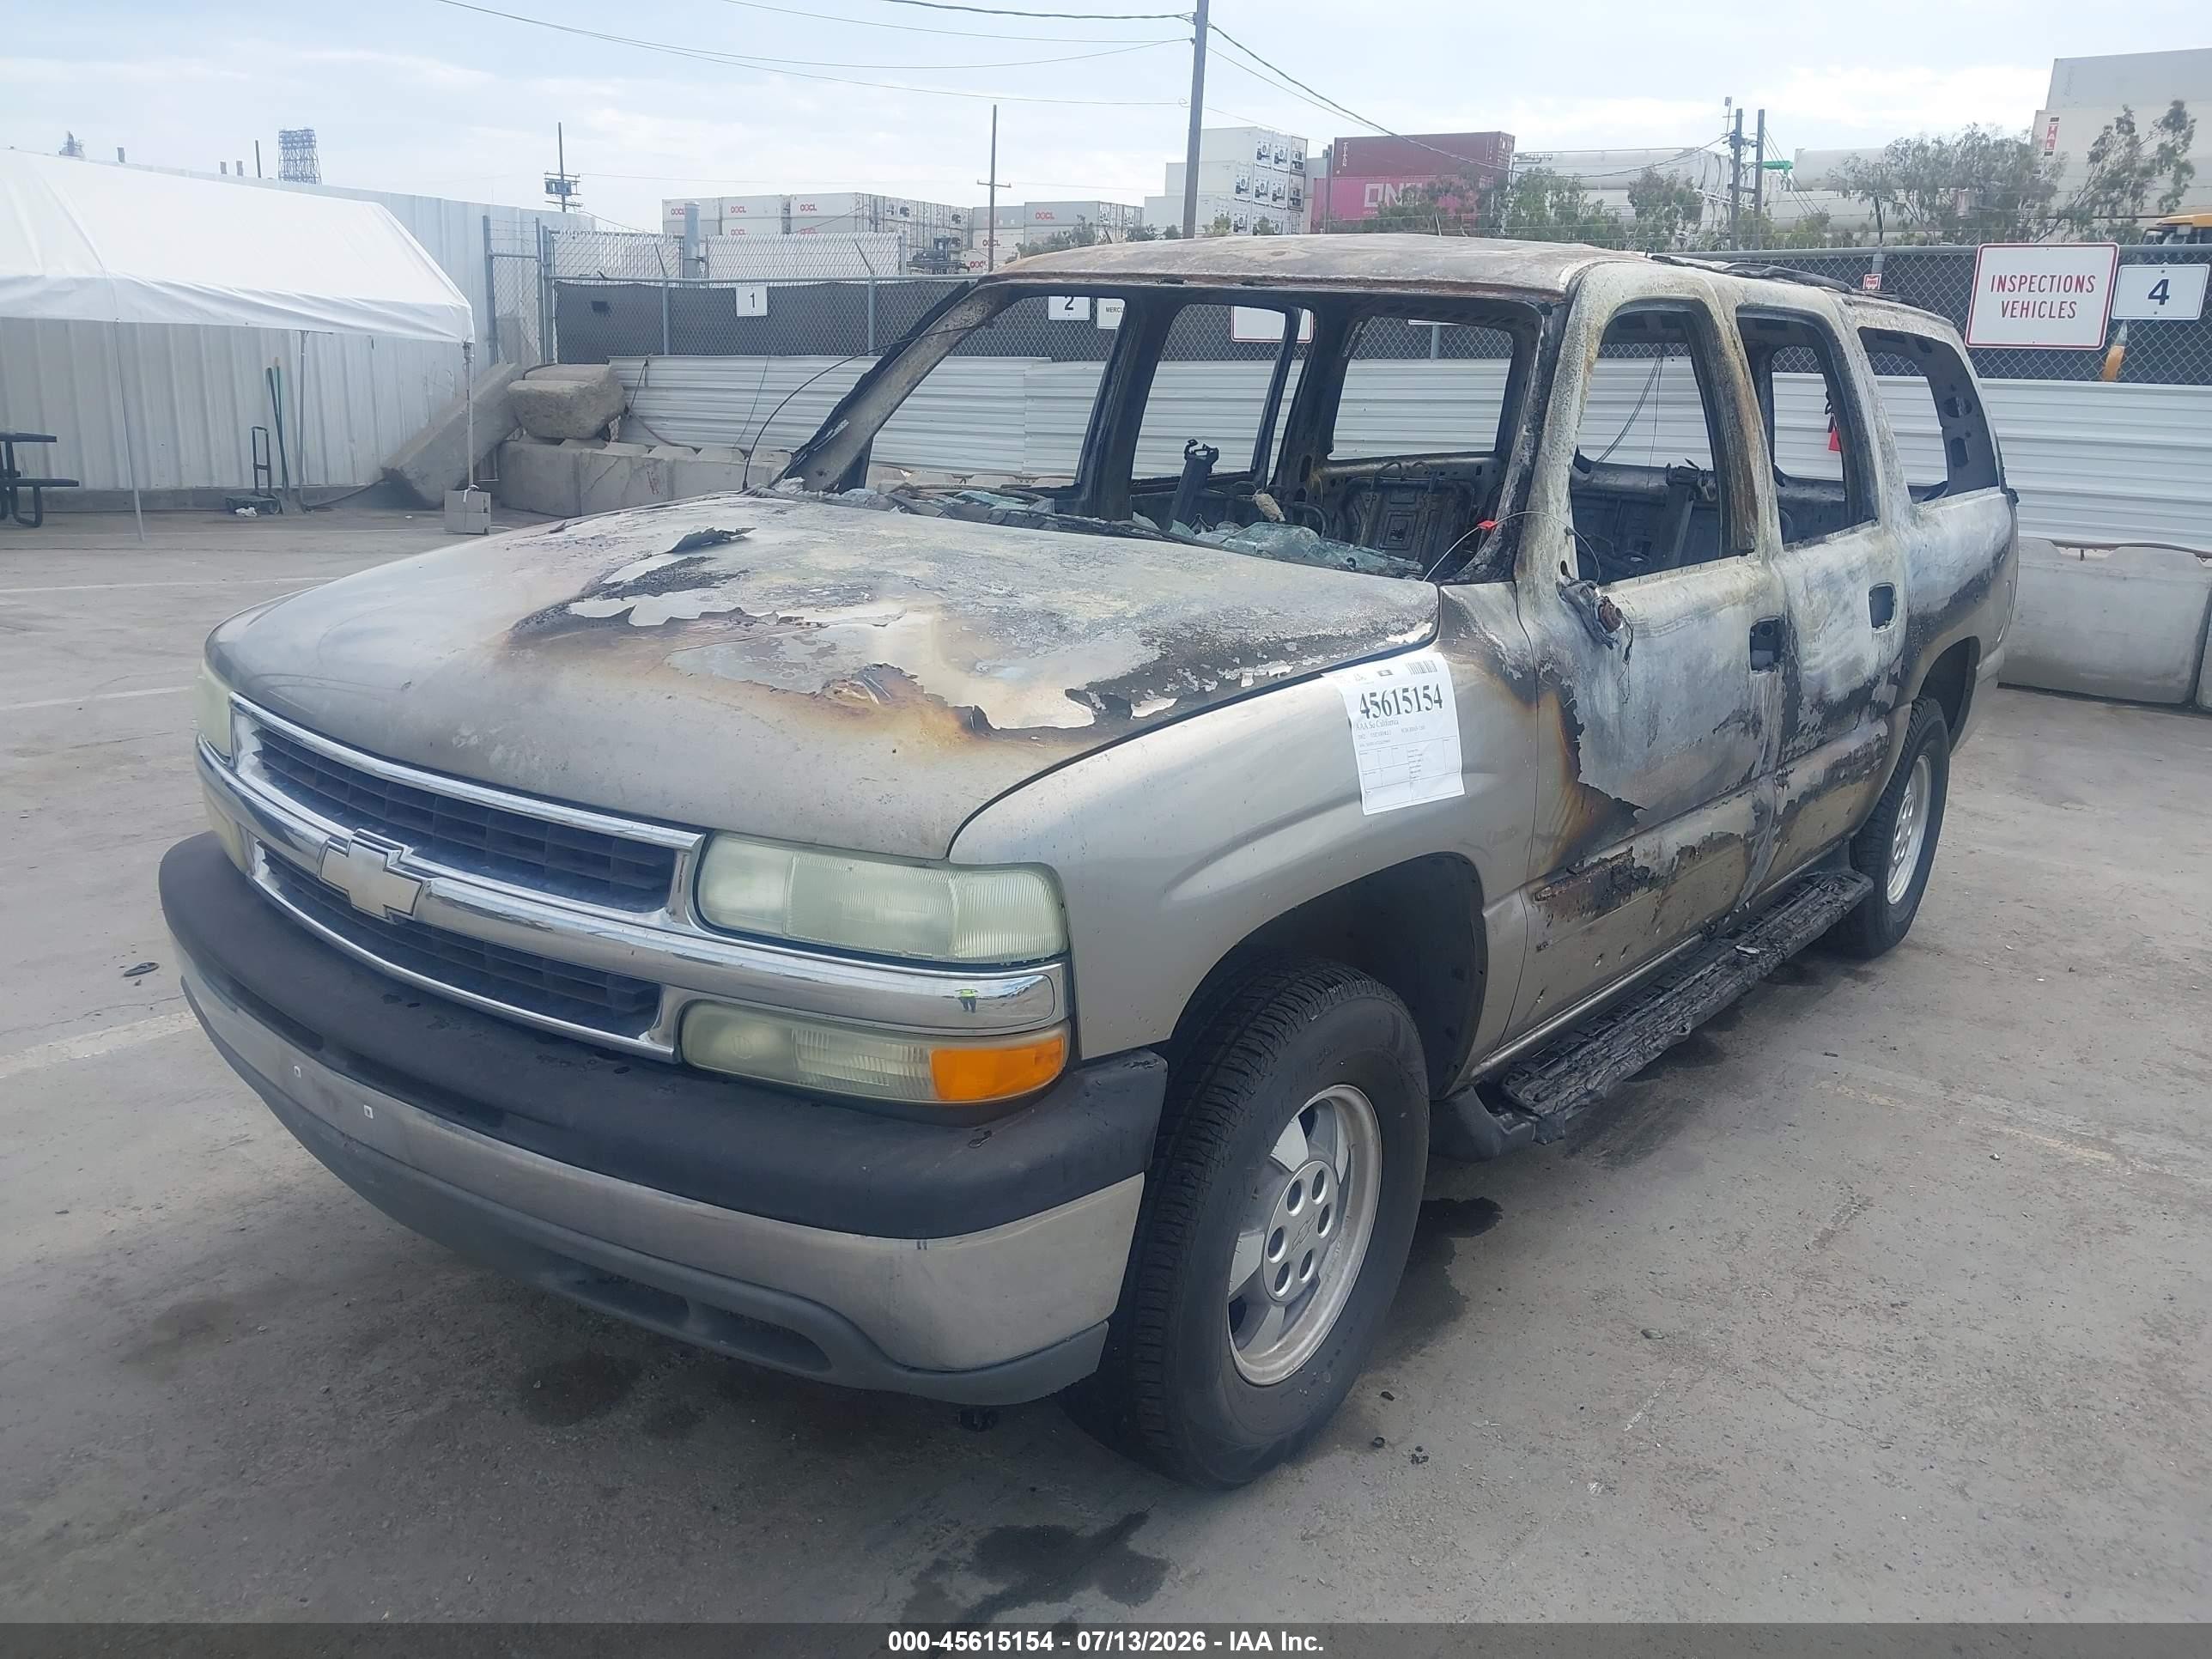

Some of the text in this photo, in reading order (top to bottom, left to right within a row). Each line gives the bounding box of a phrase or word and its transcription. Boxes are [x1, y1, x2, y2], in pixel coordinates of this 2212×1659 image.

[1364, 182, 1423, 208] ON
[730, 205, 747, 214] OOCL
[799, 204, 817, 212] OOCL
[1035, 211, 1055, 220] OOCL
[982, 239, 1001, 247] OCL
[1990, 274, 2096, 294] INSPECTIONS
[2148, 278, 2170, 306] 4
[750, 292, 756, 308] 1
[1064, 296, 1074, 311] 2
[2001, 301, 2077, 319] VEHICLES
[1359, 683, 1443, 720] 45615154
